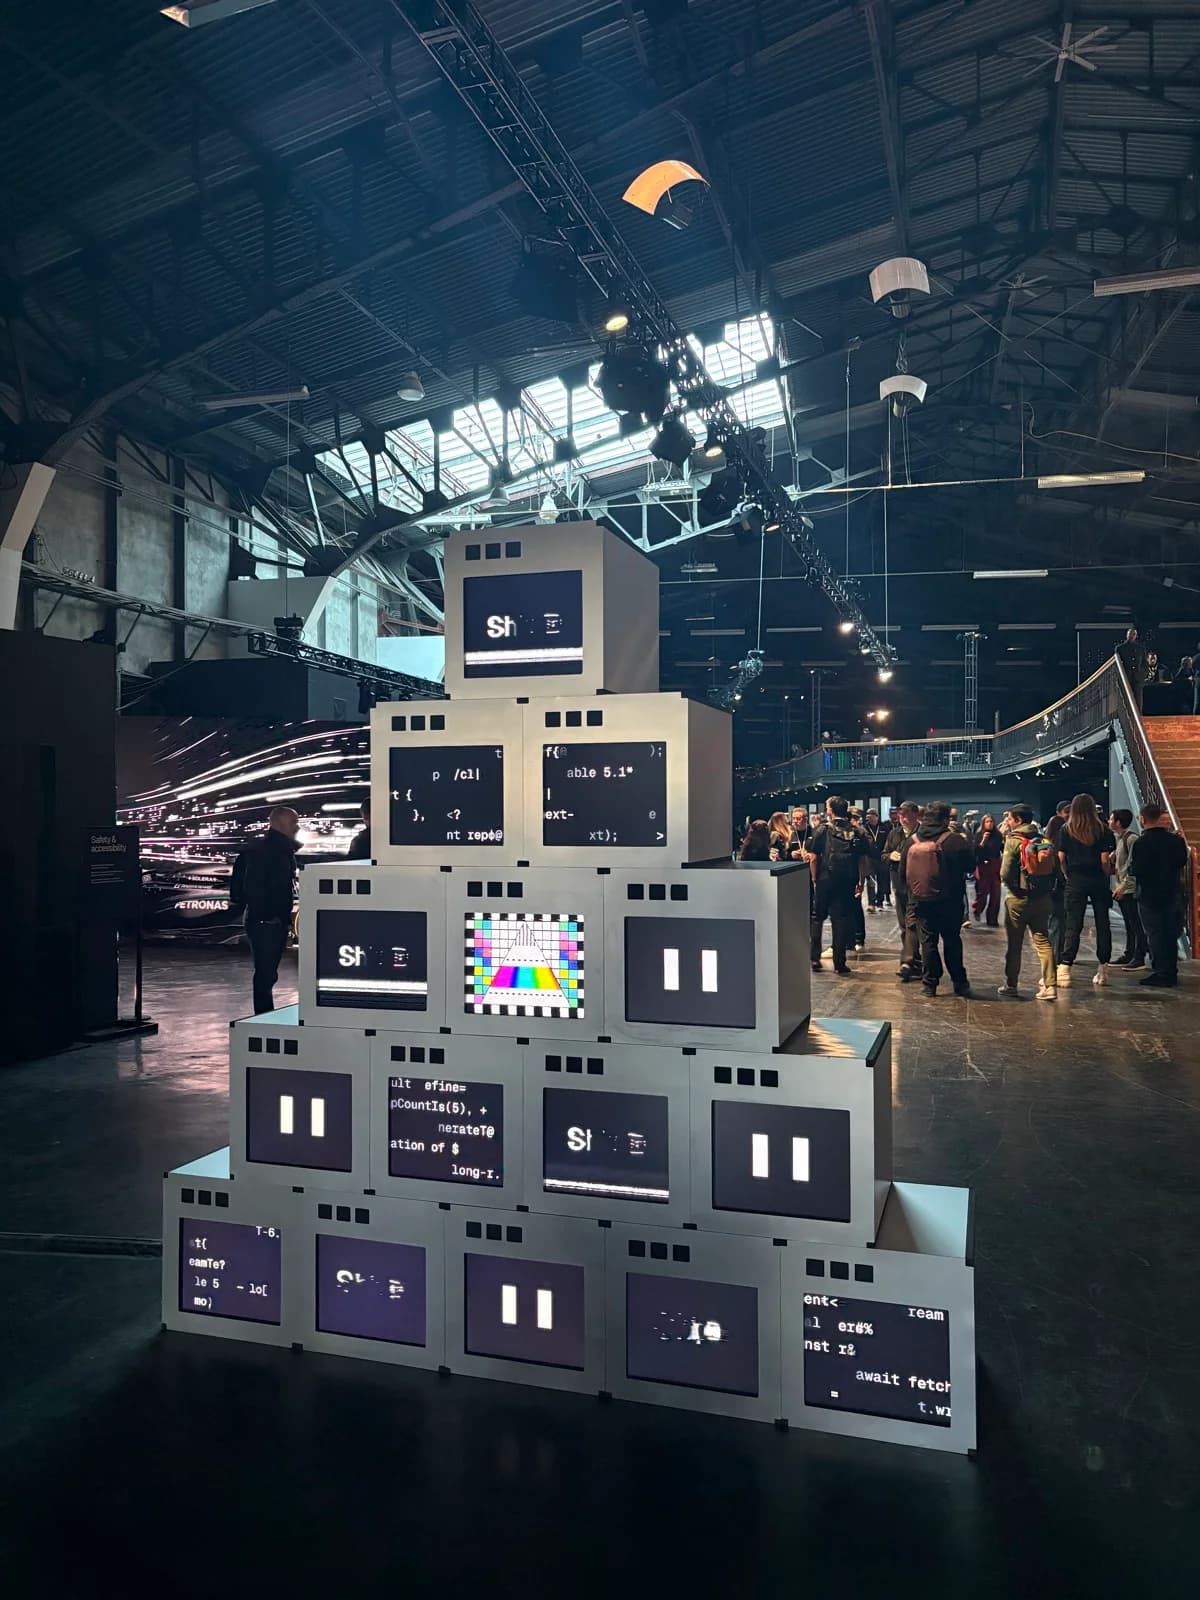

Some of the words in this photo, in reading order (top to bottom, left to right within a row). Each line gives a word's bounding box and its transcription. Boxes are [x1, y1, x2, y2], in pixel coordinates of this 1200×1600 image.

[567, 767, 596, 778] able
[447, 830, 460, 840] nt
[392, 1078, 411, 1088] ult
[391, 1139, 424, 1151] ation
[431, 1143, 445, 1152] of
[213, 1279, 219, 1288] 5
[909, 1306, 945, 1320] ream
[805, 1340, 829, 1352] nst
[856, 1371, 899, 1385] await
